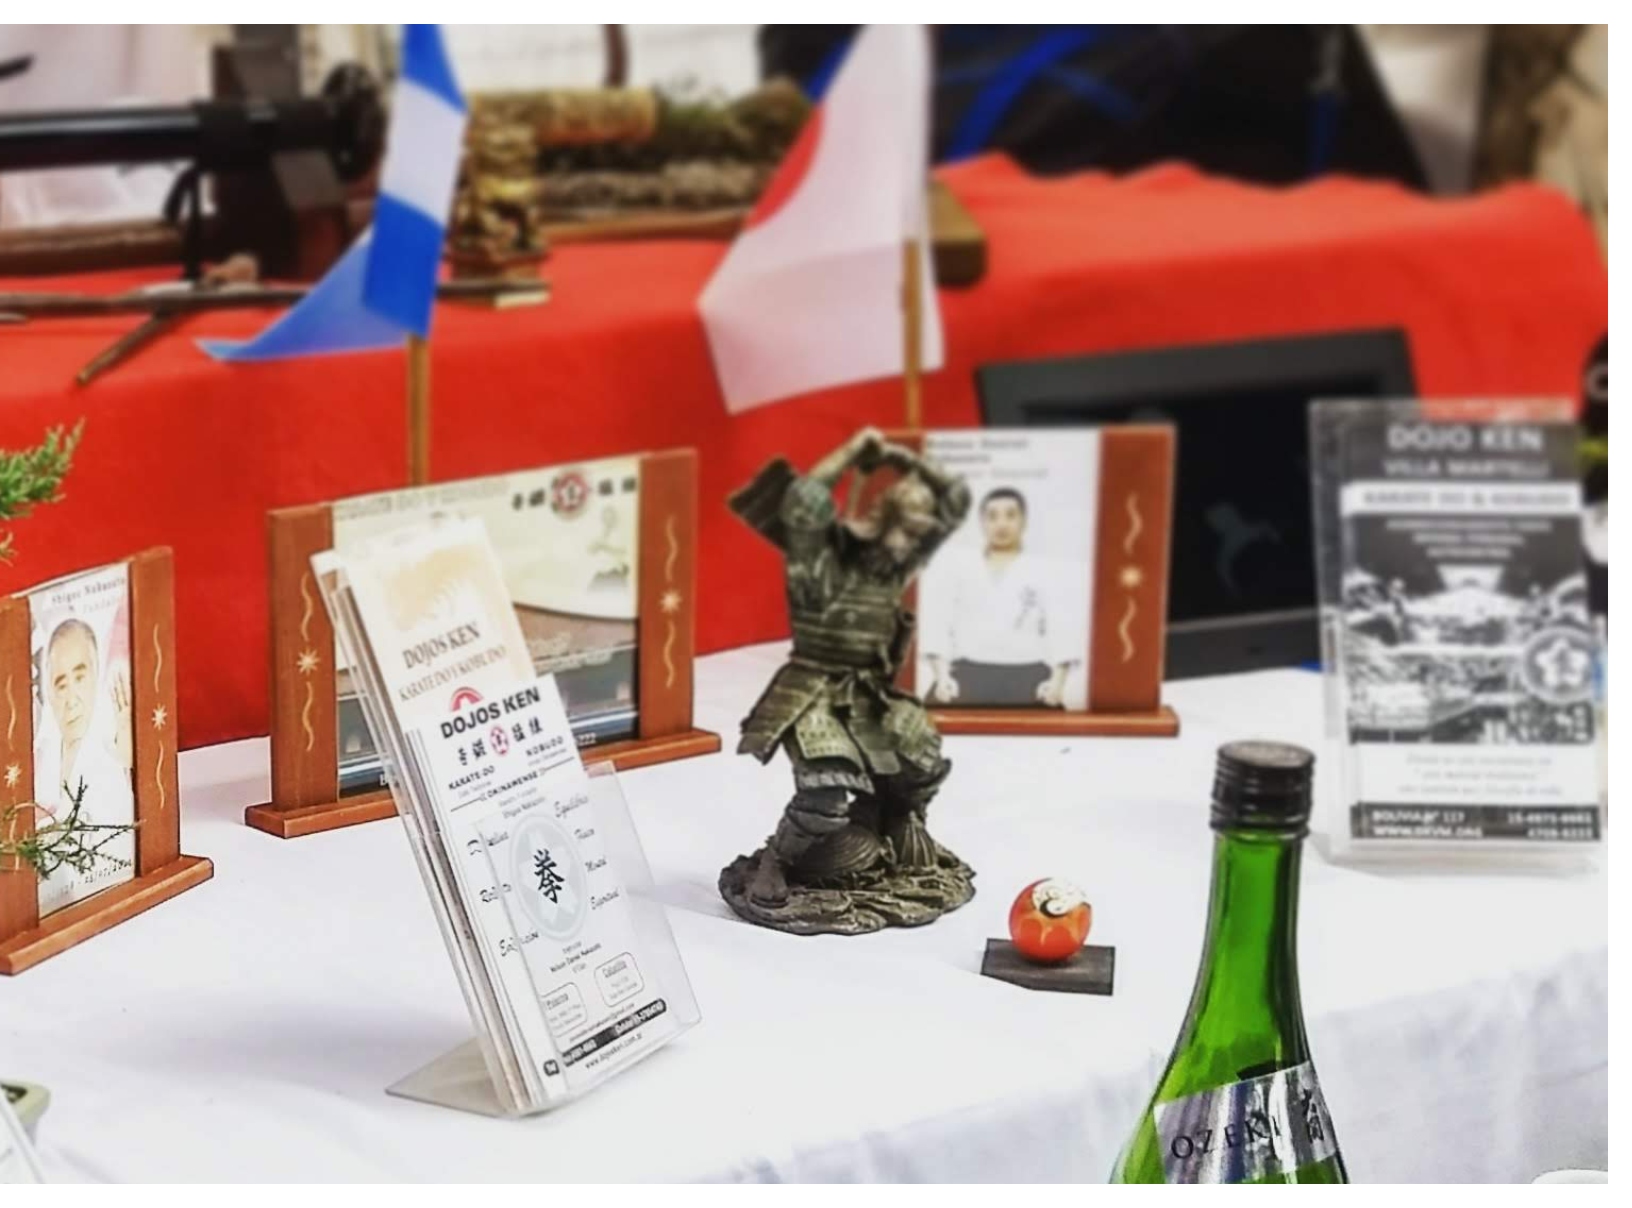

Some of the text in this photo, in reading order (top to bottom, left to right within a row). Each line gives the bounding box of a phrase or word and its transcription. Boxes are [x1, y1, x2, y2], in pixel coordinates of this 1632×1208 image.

[1387, 424, 1544, 451] DOJO KEN
[401, 620, 481, 670] DOJOS KEN
[440, 701, 501, 740] DOJOS
[502, 686, 541, 714] KEN
[1170, 1115, 1283, 1160] OZEKI
